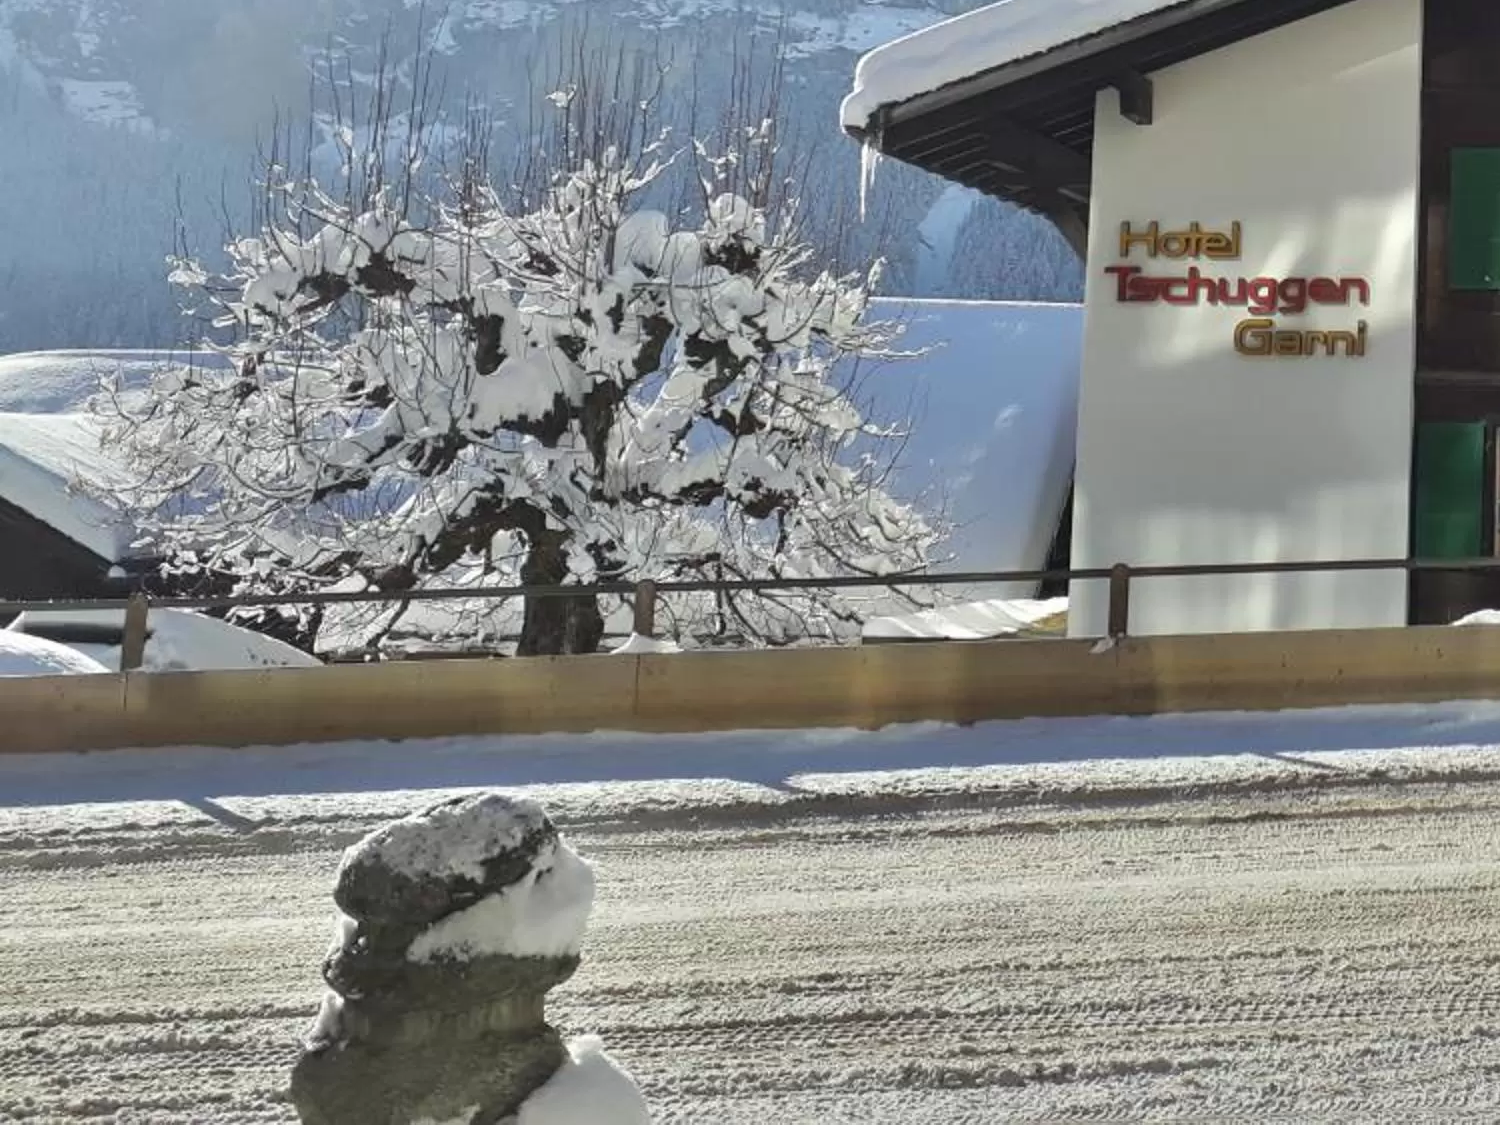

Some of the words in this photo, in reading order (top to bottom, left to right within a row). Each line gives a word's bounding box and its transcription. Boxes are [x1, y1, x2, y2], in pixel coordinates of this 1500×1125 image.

[1119, 220, 1242, 258] Hotel
[1104, 266, 1370, 314] Tschuggen
[1234, 318, 1369, 356] Garni
